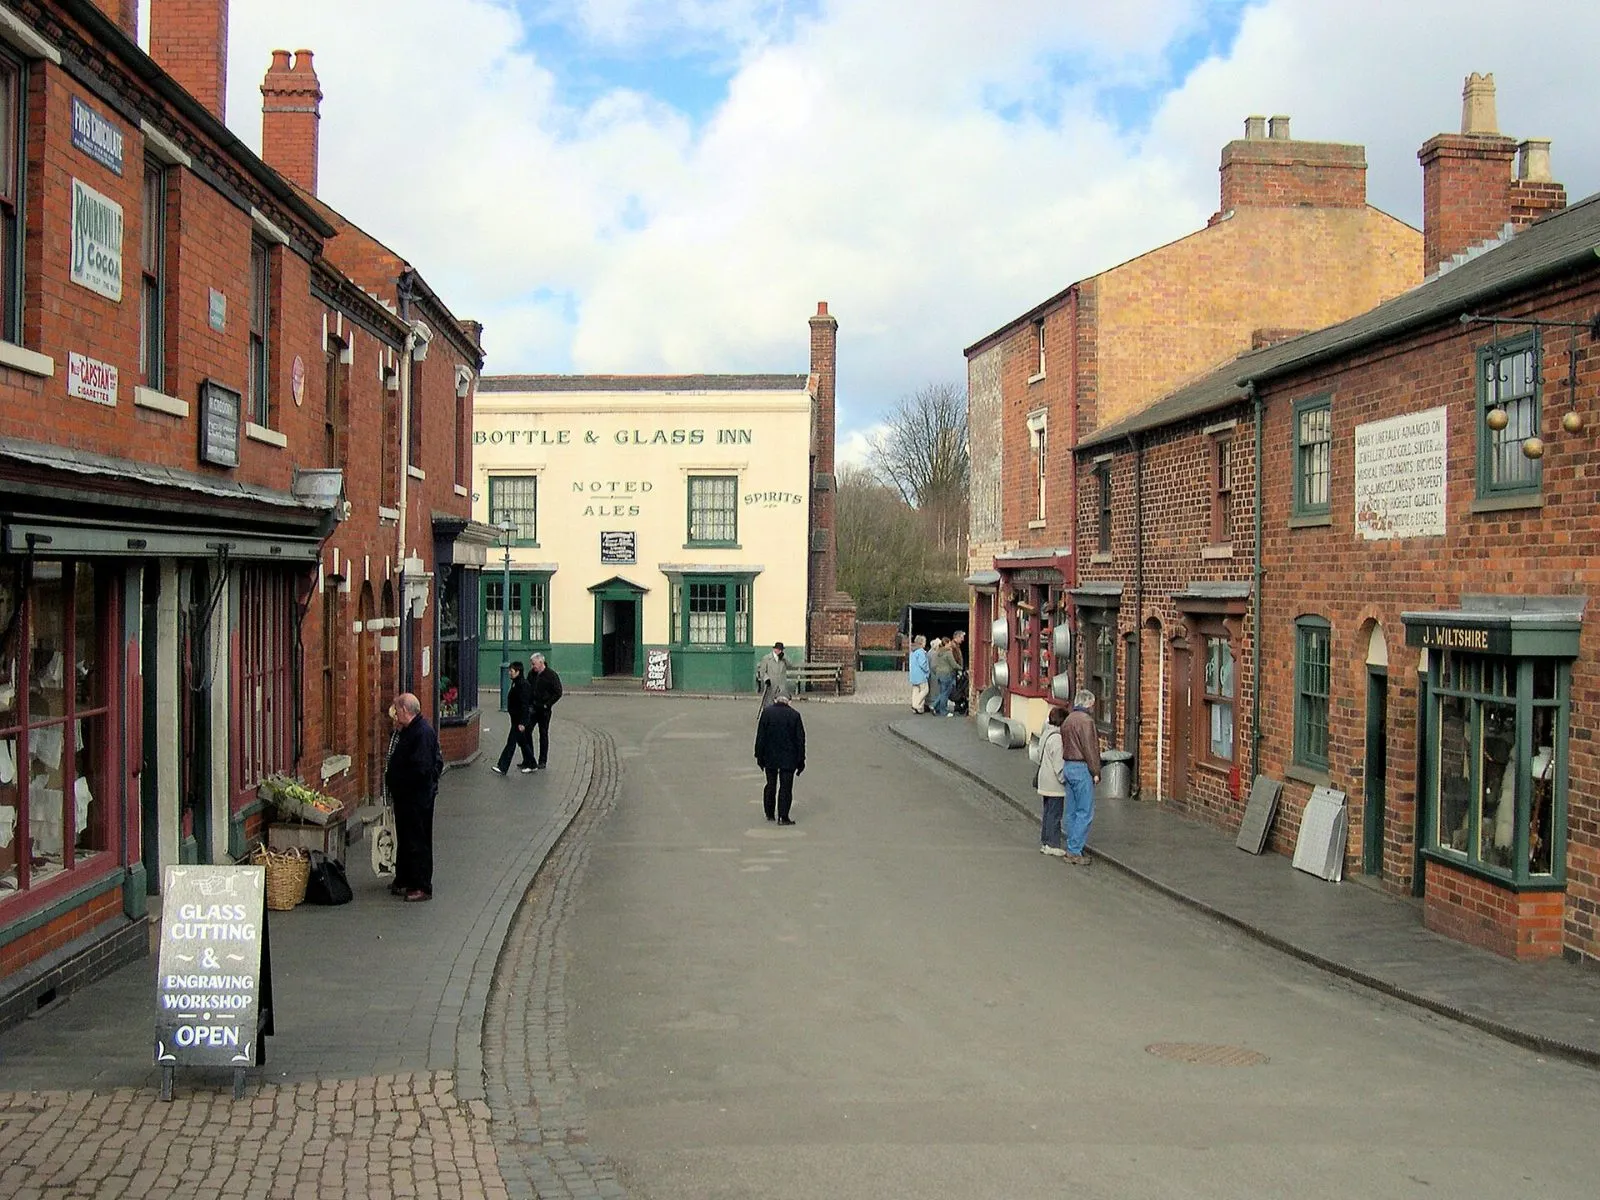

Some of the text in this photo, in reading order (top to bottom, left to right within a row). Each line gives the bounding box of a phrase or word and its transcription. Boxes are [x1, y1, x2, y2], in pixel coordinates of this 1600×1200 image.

[74, 183, 122, 272] BOURNVILLE
[87, 242, 120, 281] COCOA
[78, 386, 109, 402] CIGARETTES
[473, 429, 752, 445] BOTTLE & GLASS INN
[1357, 419, 1441, 448] MONEY LIBERALLY ADVANCED ON
[1357, 467, 1377, 481] MUSICAL
[1416, 456, 1442, 472] BICYCLES
[572, 481, 653, 492] NOTED
[1375, 477, 1416, 494] MISCELLANEOUS
[1417, 474, 1442, 489] PROPERTY
[744, 490, 802, 505] SPIRITS
[1414, 493, 1438, 508] QUALITY
[583, 505, 640, 516] ALES
[1415, 511, 1437, 526] EFFECTS
[180, 904, 246, 921] GLASS
[171, 924, 255, 941] CUTTING
[202, 947, 220, 969] &
[166, 975, 254, 989] ENGRAVING
[163, 994, 253, 1009] WORKSHOP
[177, 1025, 240, 1047] OPEN
